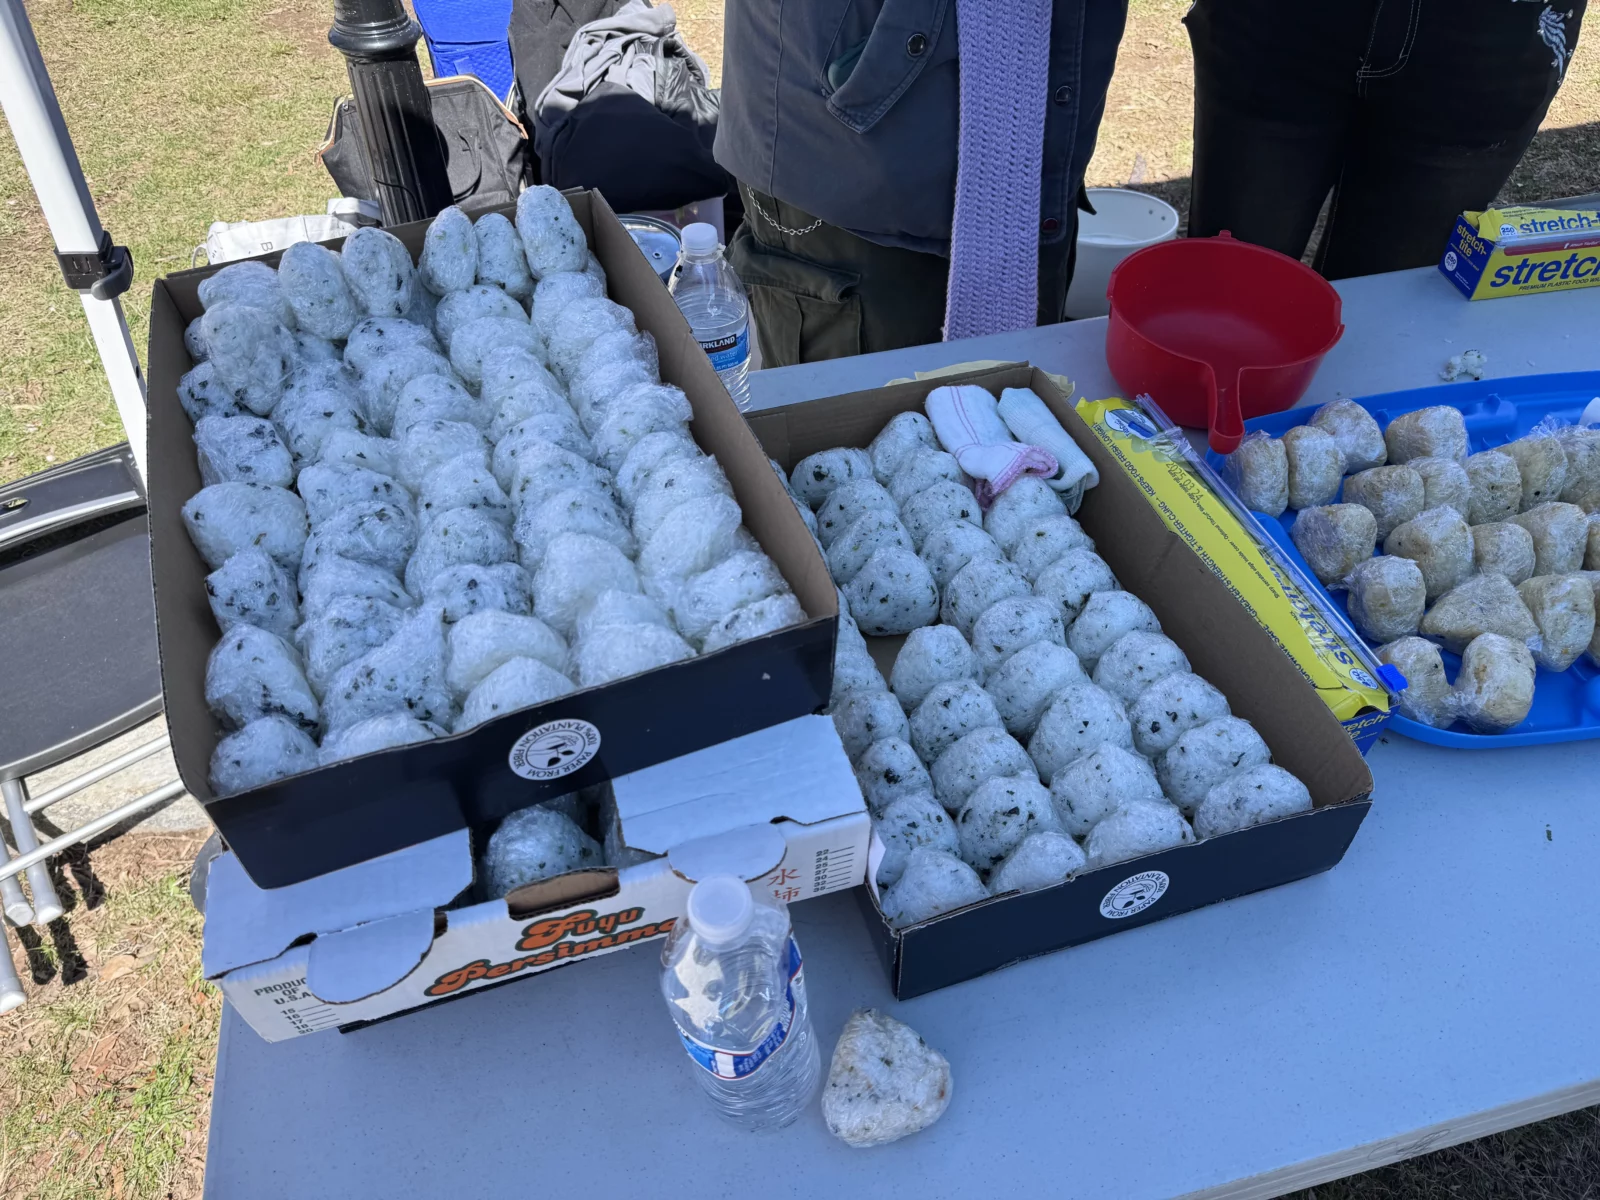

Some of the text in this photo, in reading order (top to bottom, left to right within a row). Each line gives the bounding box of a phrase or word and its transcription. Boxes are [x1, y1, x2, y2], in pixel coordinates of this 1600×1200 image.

[1456, 224, 1487, 255] stretch-
[1459, 239, 1472, 257] tite
[1518, 283, 1547, 291] PREMIUM
[1547, 280, 1572, 288] PLASTIC
[1571, 278, 1589, 286] FOOD
[700, 336, 736, 350] IRKLAND
[1108, 442, 1128, 463] FRESH
[1123, 459, 1141, 478] FOOD
[1136, 475, 1156, 497] KEEPS
[1165, 459, 1204, 501] 2025 03 24
[1213, 523, 1229, 540] Optional
[1228, 540, 1240, 552] cover
[1157, 500, 1258, 619] GREATER STRENGTH & TIGHTER CLING
[1236, 550, 1249, 563] inside
[1246, 560, 1257, 572] edge
[1253, 570, 1270, 587] serrated
[1267, 585, 1280, 599] Sharp
[519, 721, 587, 748] PLANTATION
[513, 749, 526, 770] FIBER
[563, 751, 592, 773] PAPER
[526, 768, 560, 778] FROM
[815, 849, 830, 857] 22
[1113, 872, 1164, 893] PLANTATION
[1106, 909, 1129, 917] FROM
[1130, 897, 1156, 914] PAPER
[515, 907, 646, 951] Fuyu
[424, 917, 679, 996] Persimmo
[254, 977, 306, 996] PRODUC
[282, 987, 300, 996] OF
[285, 1013, 300, 1021] 16
